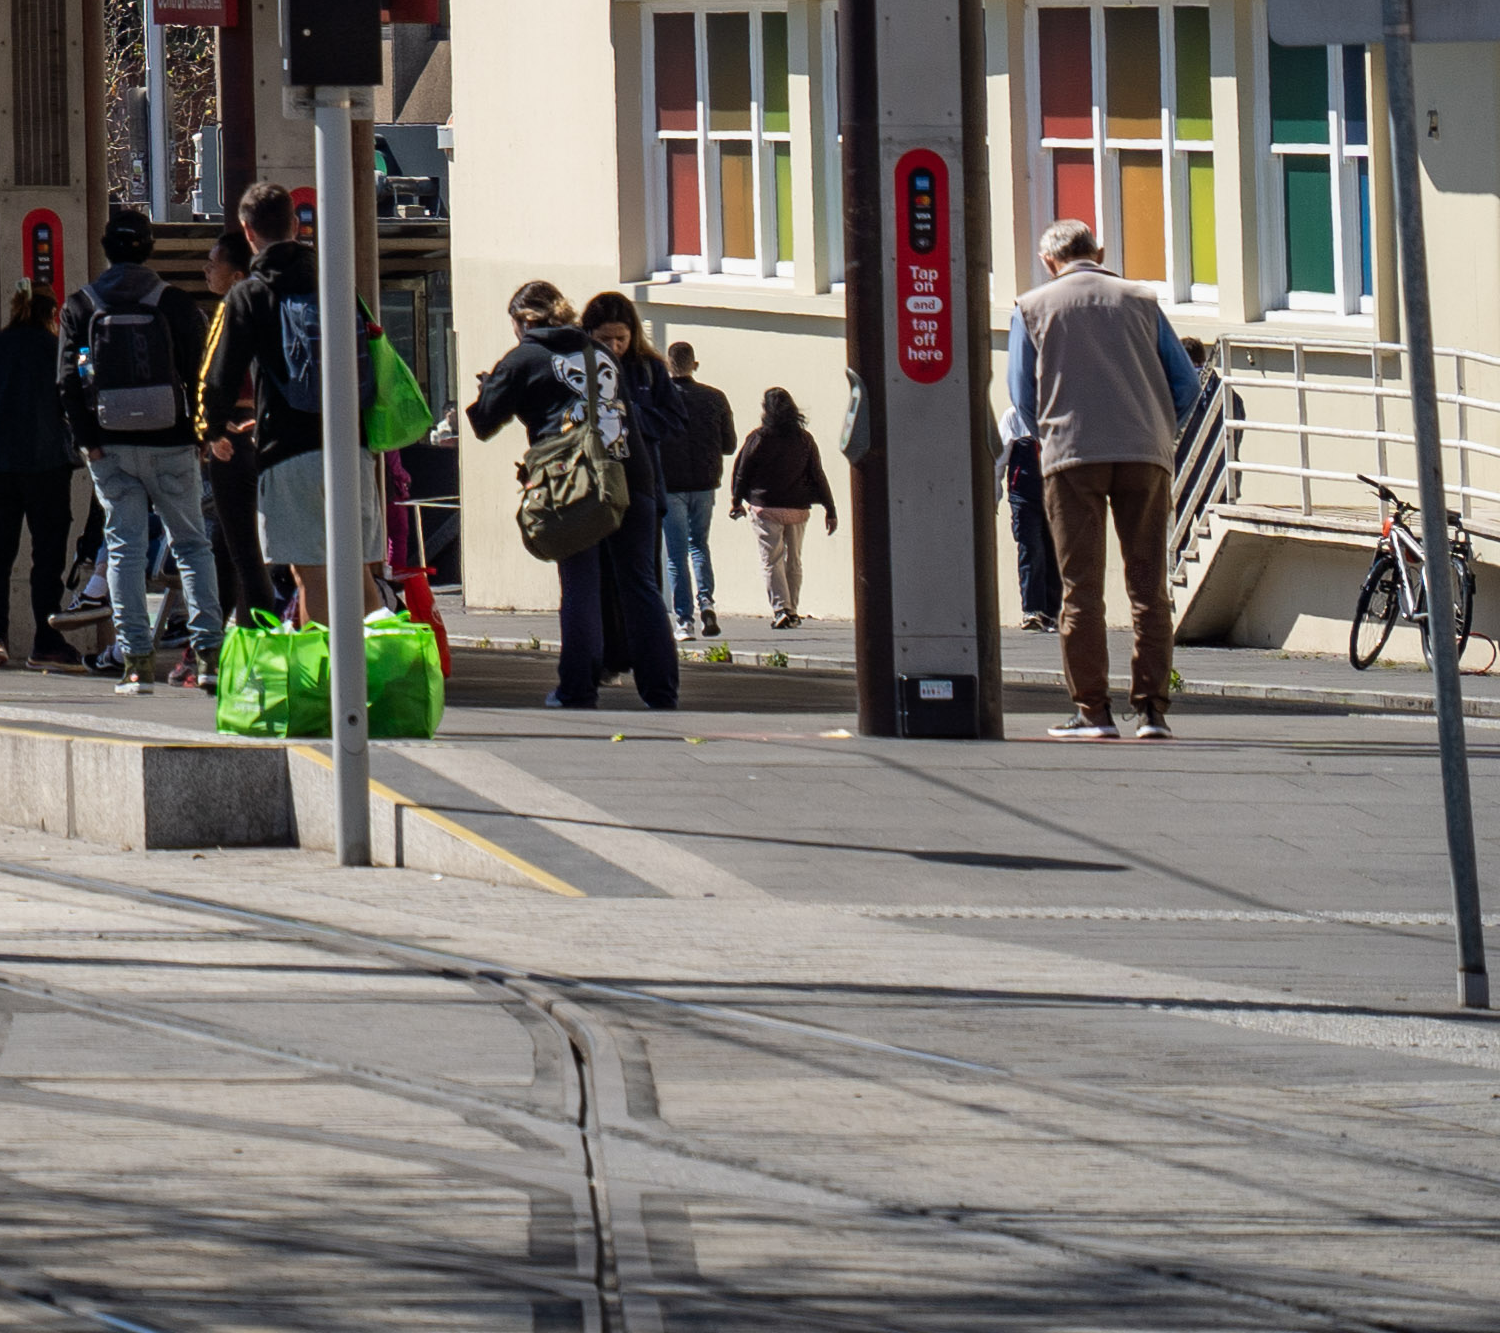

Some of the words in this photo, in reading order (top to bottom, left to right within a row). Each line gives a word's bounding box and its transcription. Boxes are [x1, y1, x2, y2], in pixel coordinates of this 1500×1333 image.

[909, 265, 938, 282] Tap
[914, 281, 934, 292] on
[914, 299, 935, 310] and
[912, 318, 938, 333] tap
[914, 333, 936, 346] off
[908, 346, 943, 361] here
